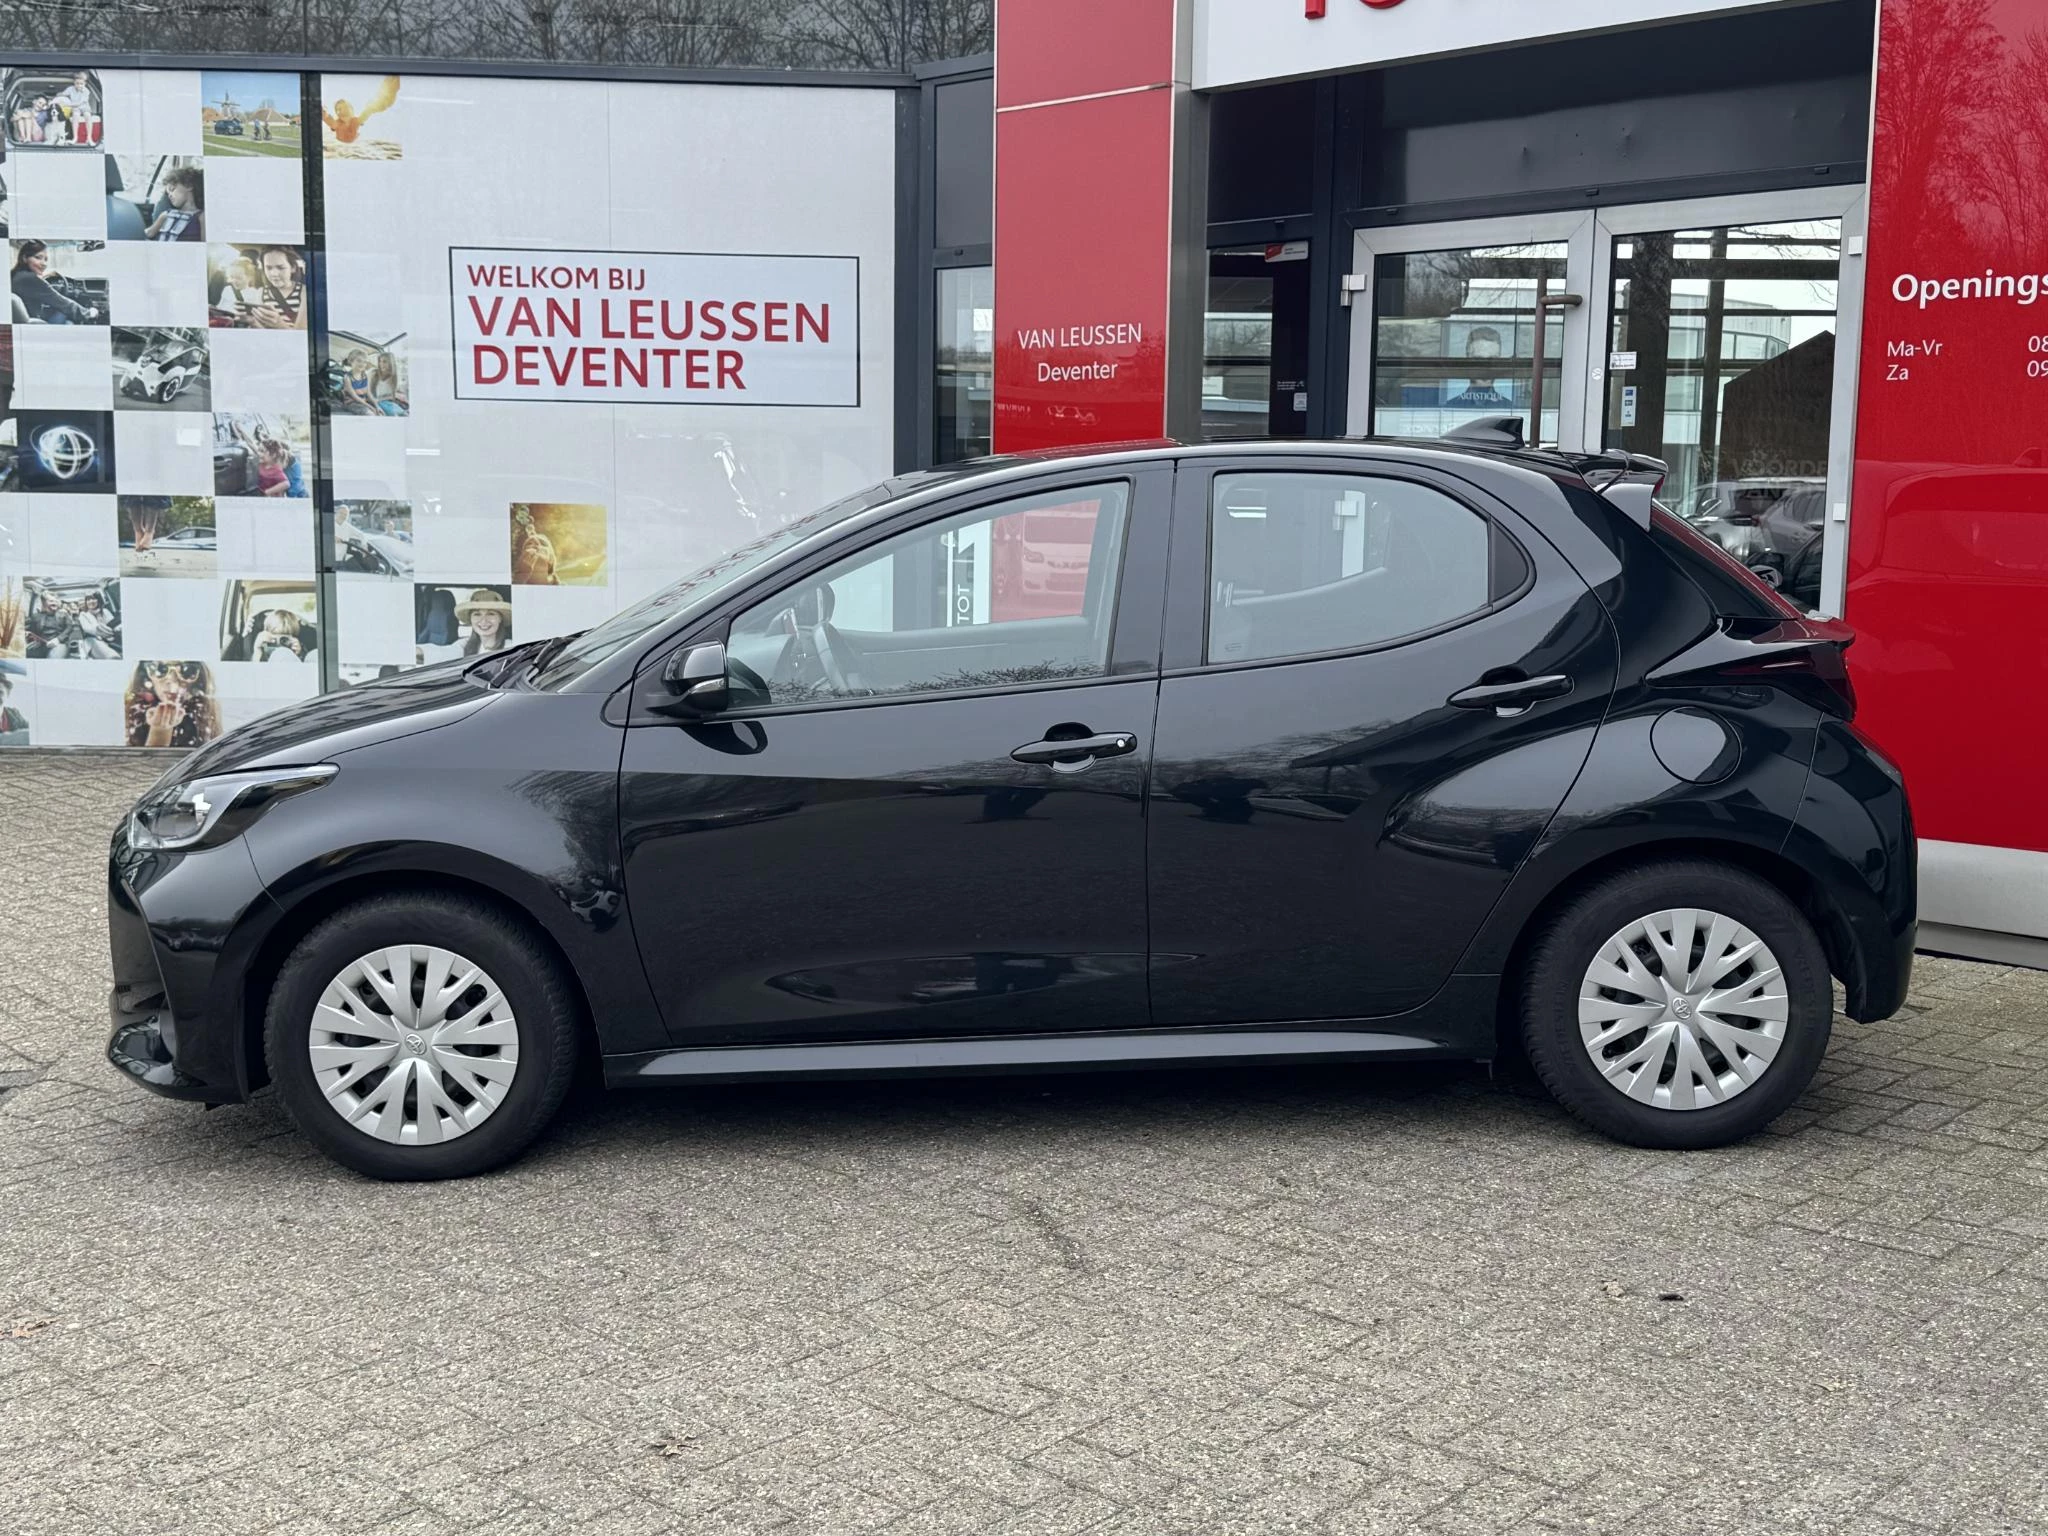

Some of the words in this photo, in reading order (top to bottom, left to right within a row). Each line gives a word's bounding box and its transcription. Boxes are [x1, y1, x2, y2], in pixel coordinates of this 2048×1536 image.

[467, 264, 599, 290] WELKOM
[608, 267, 645, 291] BIJ
[467, 295, 581, 339] VAN
[600, 298, 830, 343] LEUSSEN
[1017, 328, 1055, 349] VAN
[1060, 322, 1142, 347] LEUSSEN
[1887, 339, 1943, 357] Ma-Vr
[472, 343, 747, 390] DEVENTER
[1037, 360, 1119, 382] Deventer
[1886, 363, 1909, 381] Za
